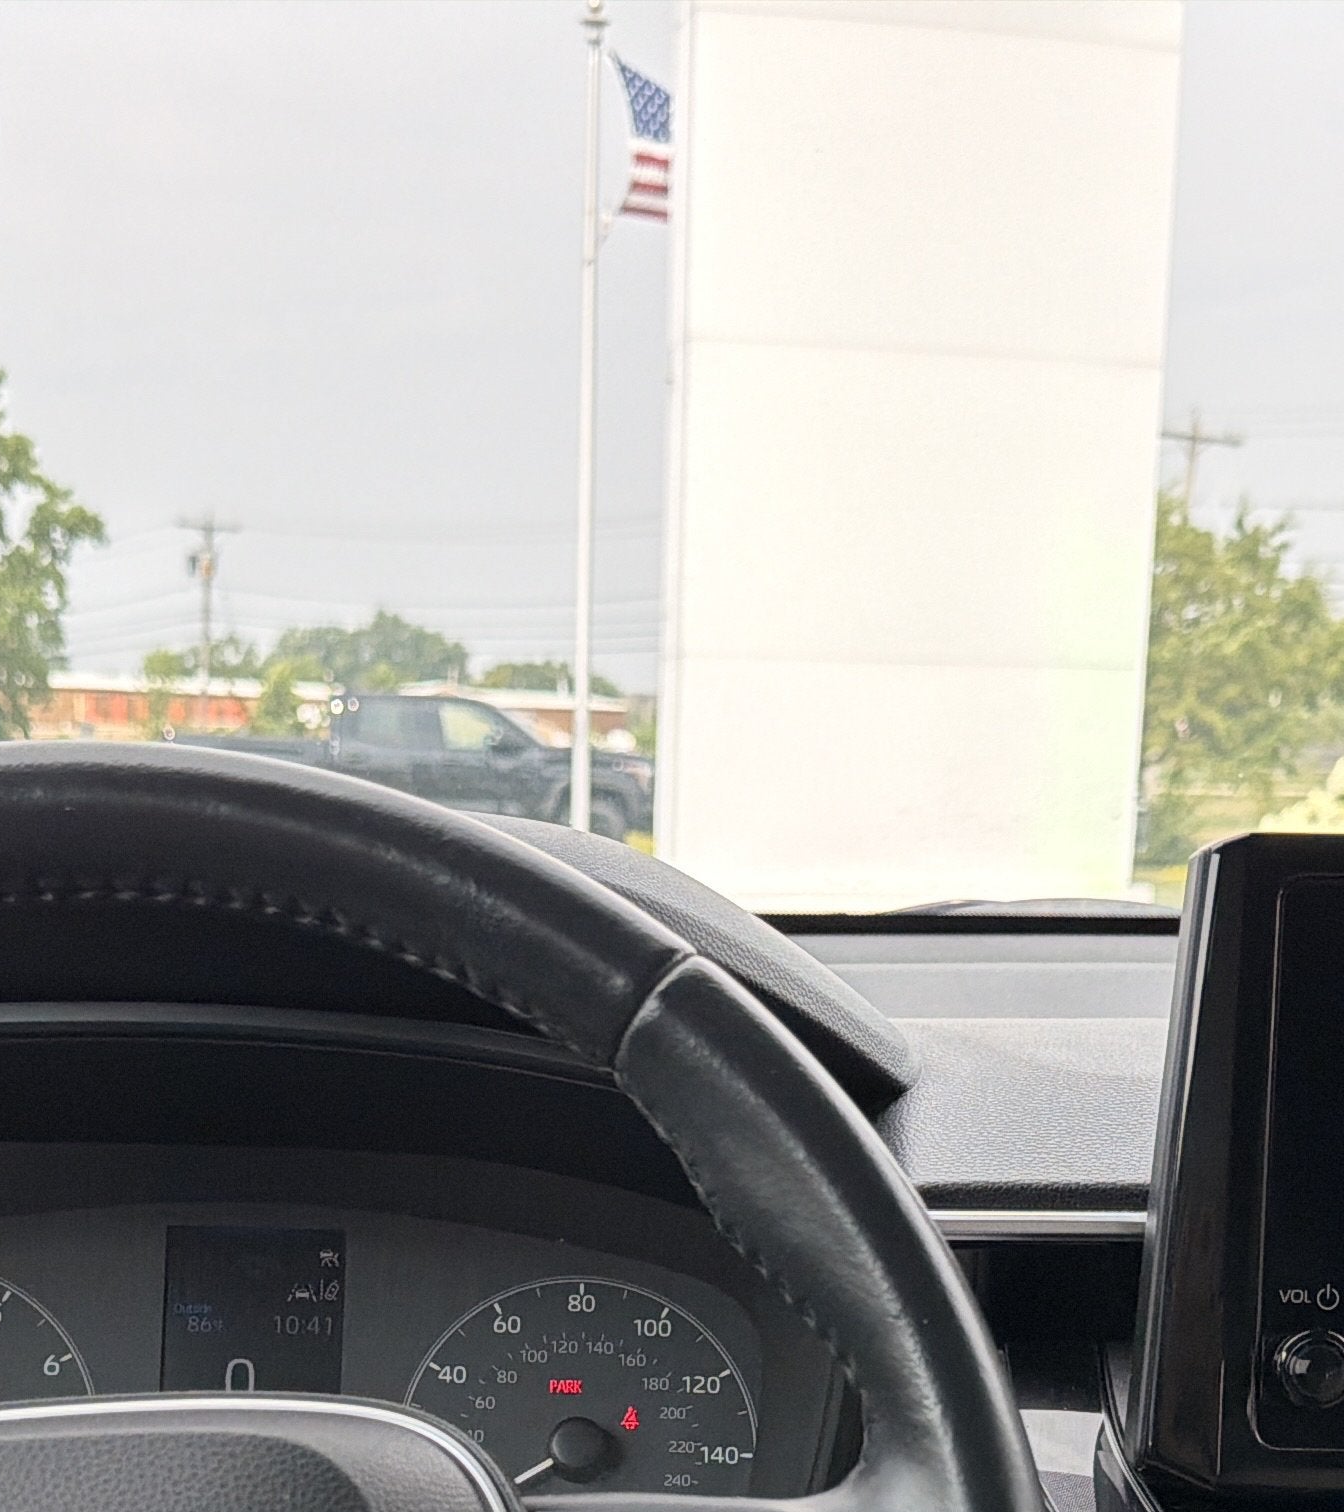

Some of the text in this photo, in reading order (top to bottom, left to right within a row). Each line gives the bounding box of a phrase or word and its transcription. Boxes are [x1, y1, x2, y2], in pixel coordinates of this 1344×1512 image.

[567, 1294, 596, 1313] 80
[1279, 1289, 1312, 1304] VOL
[273, 1315, 334, 1336] 10:41
[493, 1315, 522, 1334] 60
[633, 1319, 672, 1338] 100
[550, 1340, 579, 1354] 120
[585, 1340, 614, 1355] 140
[519, 1349, 549, 1364] 100
[617, 1352, 647, 1367] 160
[43, 1354, 61, 1377] 6
[437, 1365, 468, 1384] 40
[496, 1370, 519, 1385] 80
[549, 1379, 584, 1394] PARK
[641, 1377, 670, 1391] 180
[681, 1376, 721, 1395] 120
[474, 1396, 497, 1410] 60
[659, 1406, 687, 1420] 200
[668, 1440, 695, 1454] 220
[700, 1446, 739, 1465] 140
[663, 1474, 691, 1487] 240
